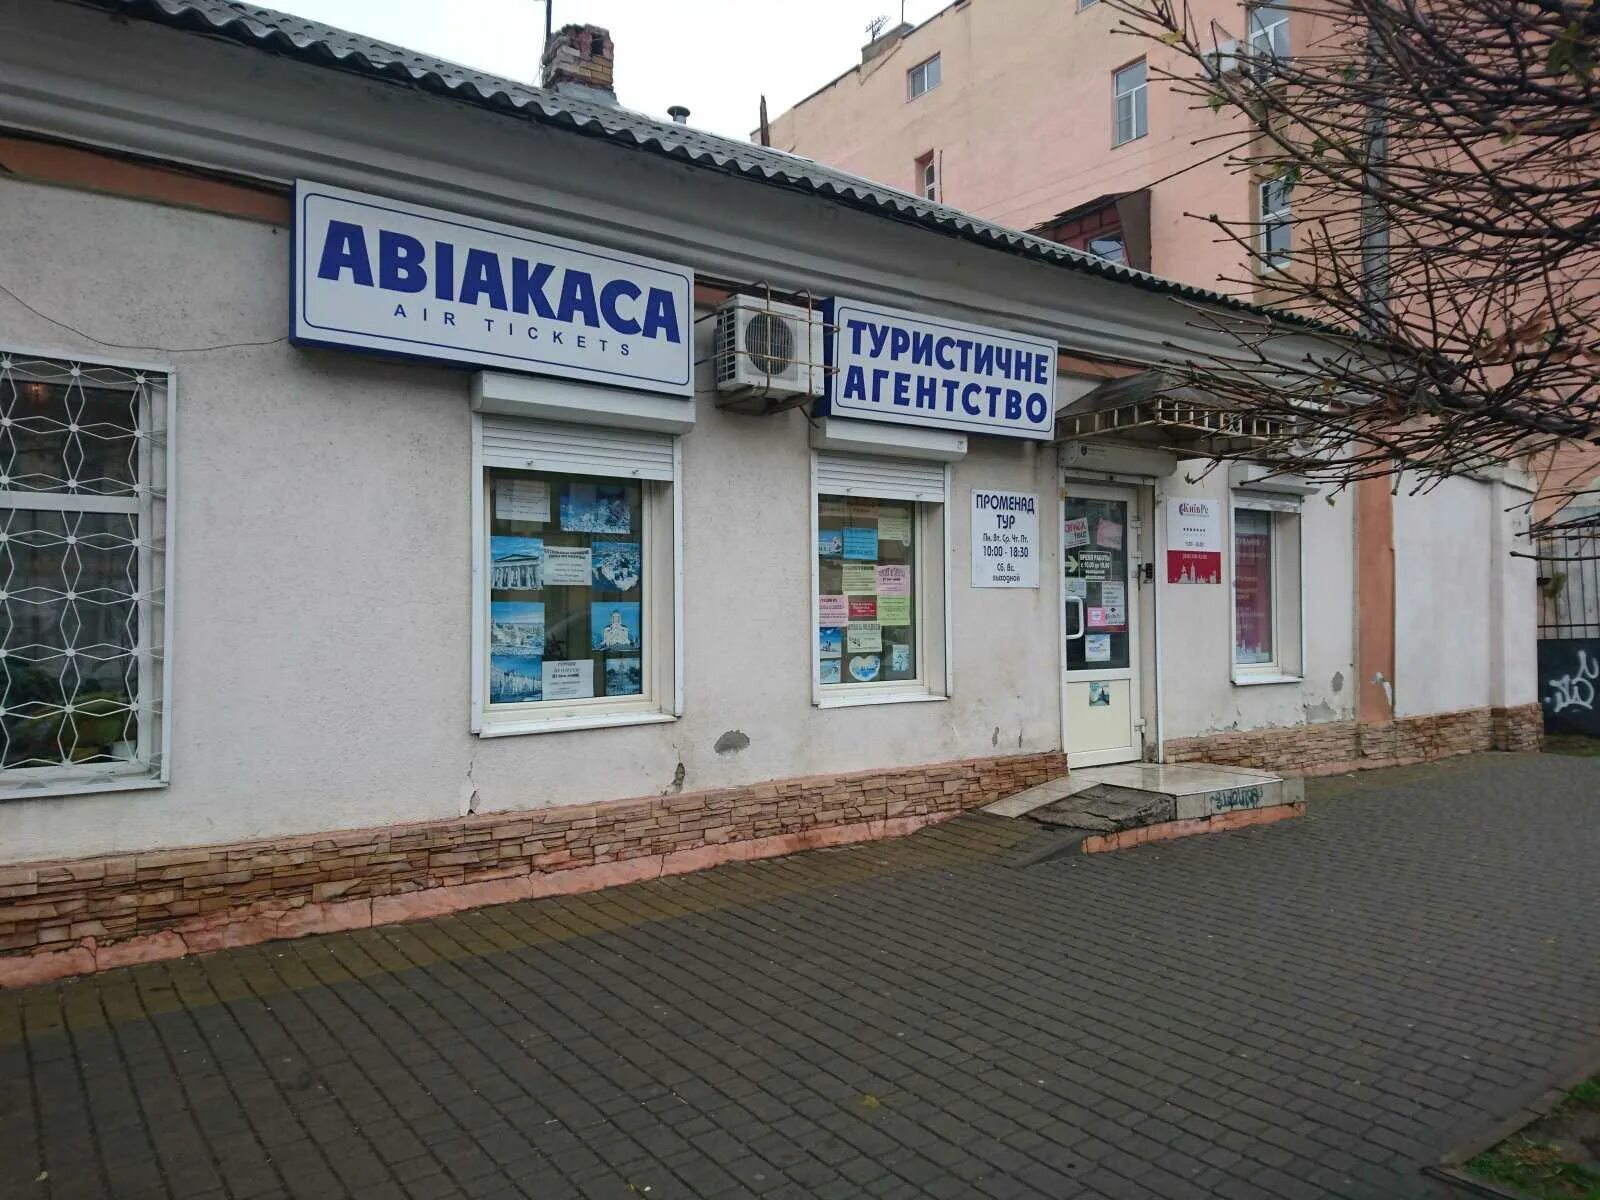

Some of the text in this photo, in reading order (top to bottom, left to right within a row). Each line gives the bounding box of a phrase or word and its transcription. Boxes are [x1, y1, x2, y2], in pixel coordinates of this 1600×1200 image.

[317, 219, 681, 344] АВІАКАСА
[394, 304, 630, 356] AIR TICKETS
[847, 319, 1049, 385] ТУРИСТИЧНЕ
[843, 365, 1048, 424] АГЕНТСТВО
[976, 494, 1035, 514] ПРОМЕНАД
[996, 514, 1016, 529] ТУР
[983, 545, 1003, 556] 10:00
[1010, 546, 1029, 557] 18:30
